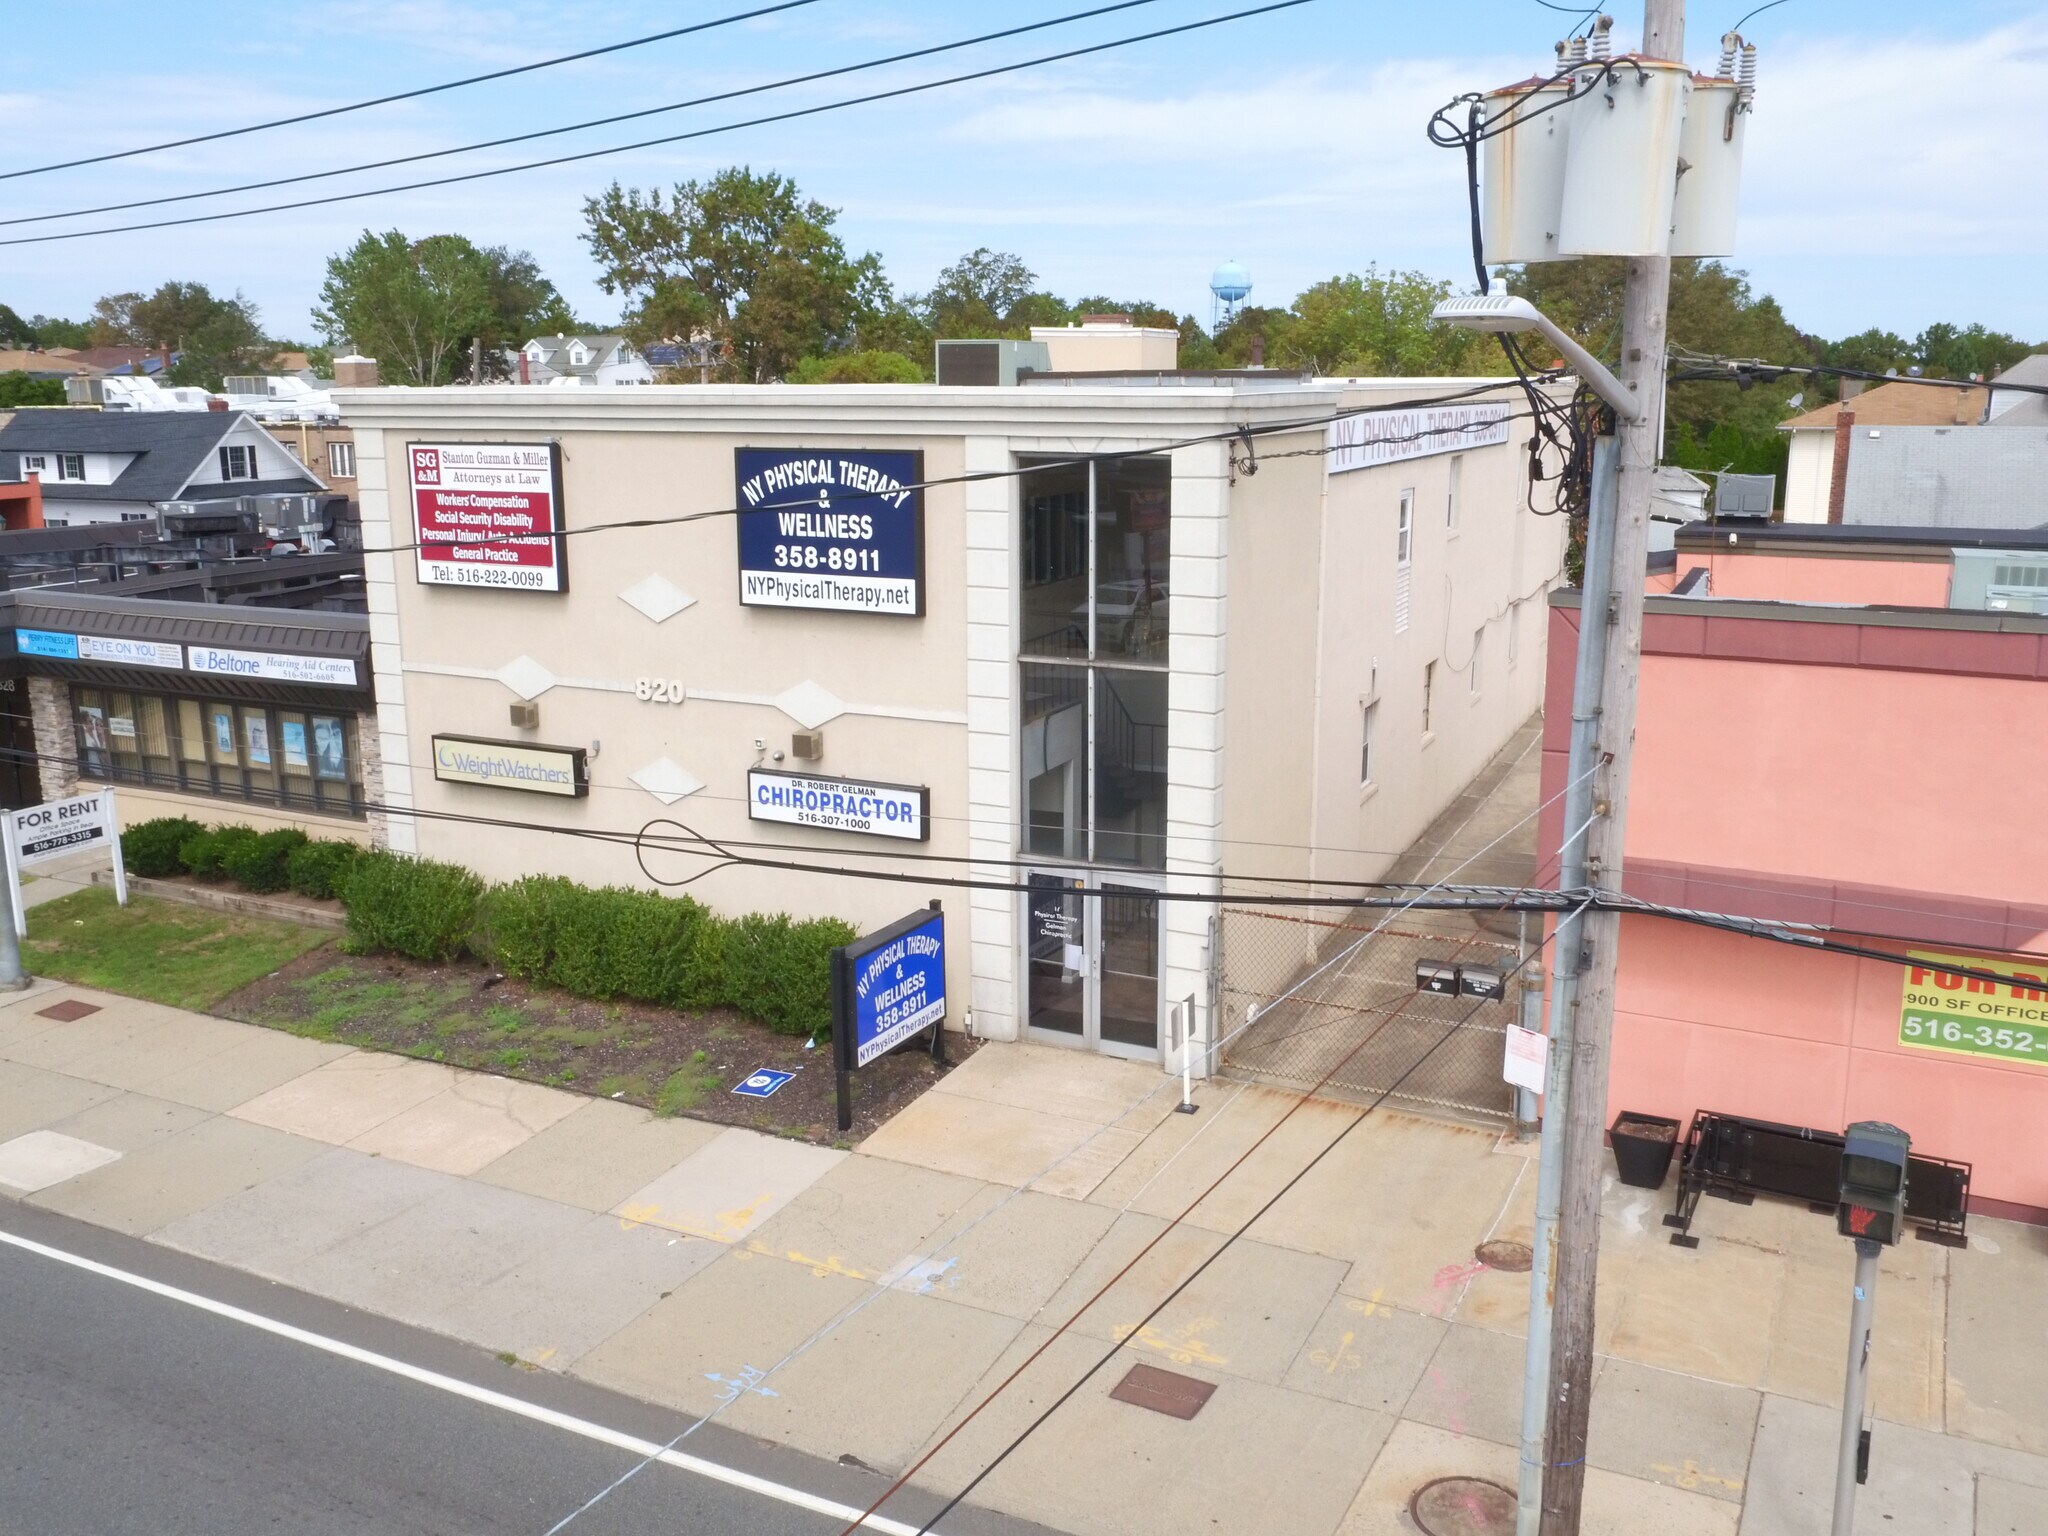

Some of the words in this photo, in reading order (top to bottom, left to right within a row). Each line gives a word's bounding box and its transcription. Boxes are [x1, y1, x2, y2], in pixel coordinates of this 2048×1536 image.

[1335, 420, 1356, 466] NY
[1363, 414, 1423, 460] PHYSICAL
[1427, 410, 1471, 450] THERAPY
[416, 452, 437, 467] SG
[442, 450, 475, 465] Stanton
[476, 452, 511, 465] Guzman
[513, 453, 520, 465] &
[523, 452, 548, 466] Miller
[418, 470, 438, 482] &M
[453, 472, 502, 486] Attorneys
[505, 474, 515, 484] at
[518, 473, 540, 485] Law
[742, 475, 765, 506] NY
[764, 459, 835, 493] PHYSICAL
[839, 460, 911, 509] THERAPY
[470, 494, 529, 510] Compensation
[818, 489, 830, 508] &
[435, 511, 458, 524] Social
[459, 512, 492, 527] Security
[493, 514, 533, 529] Disability
[778, 512, 873, 540] WELLNESS
[422, 528, 456, 542] Personal
[453, 546, 483, 560] General
[485, 548, 519, 562] Practice
[774, 545, 879, 572] 358-8911
[432, 566, 453, 581] Tel:
[457, 568, 543, 586] 516-222-0099
[747, 576, 909, 607] NYPhysicalTherapy.net
[92, 640, 113, 652] EYE
[115, 642, 131, 654] ON
[134, 644, 156, 657] YOU
[208, 651, 260, 673] Beltone
[266, 656, 300, 671] Hearing
[301, 660, 316, 670] Aid
[318, 661, 352, 673] Centers
[635, 677, 686, 704] 820
[791, 780, 806, 789] DR.
[807, 781, 840, 792] ROBERT
[842, 785, 876, 797] GELMAN
[758, 784, 913, 823] CHIROPRACTOR
[17, 810, 52, 830] FOR
[58, 799, 99, 820] RENT
[798, 812, 871, 830] 516-307-1000
[34, 831, 91, 852] 516-778-3315
[857, 972, 870, 999] NY
[869, 939, 905, 983] PHYSICAL
[906, 934, 941, 959] THERAPY
[895, 963, 904, 980] &
[1910, 962, 1996, 995] FOR
[874, 970, 926, 1013] WELLNESS
[876, 990, 927, 1033] 358-8911
[1906, 993, 1939, 1007] 900
[1946, 998, 1971, 1010] SF
[1978, 1003, 2048, 1022] OFFICE
[860, 1004, 942, 1062] NYPhysicalTherapy.net
[1904, 1016, 2048, 1052] 516-352-
